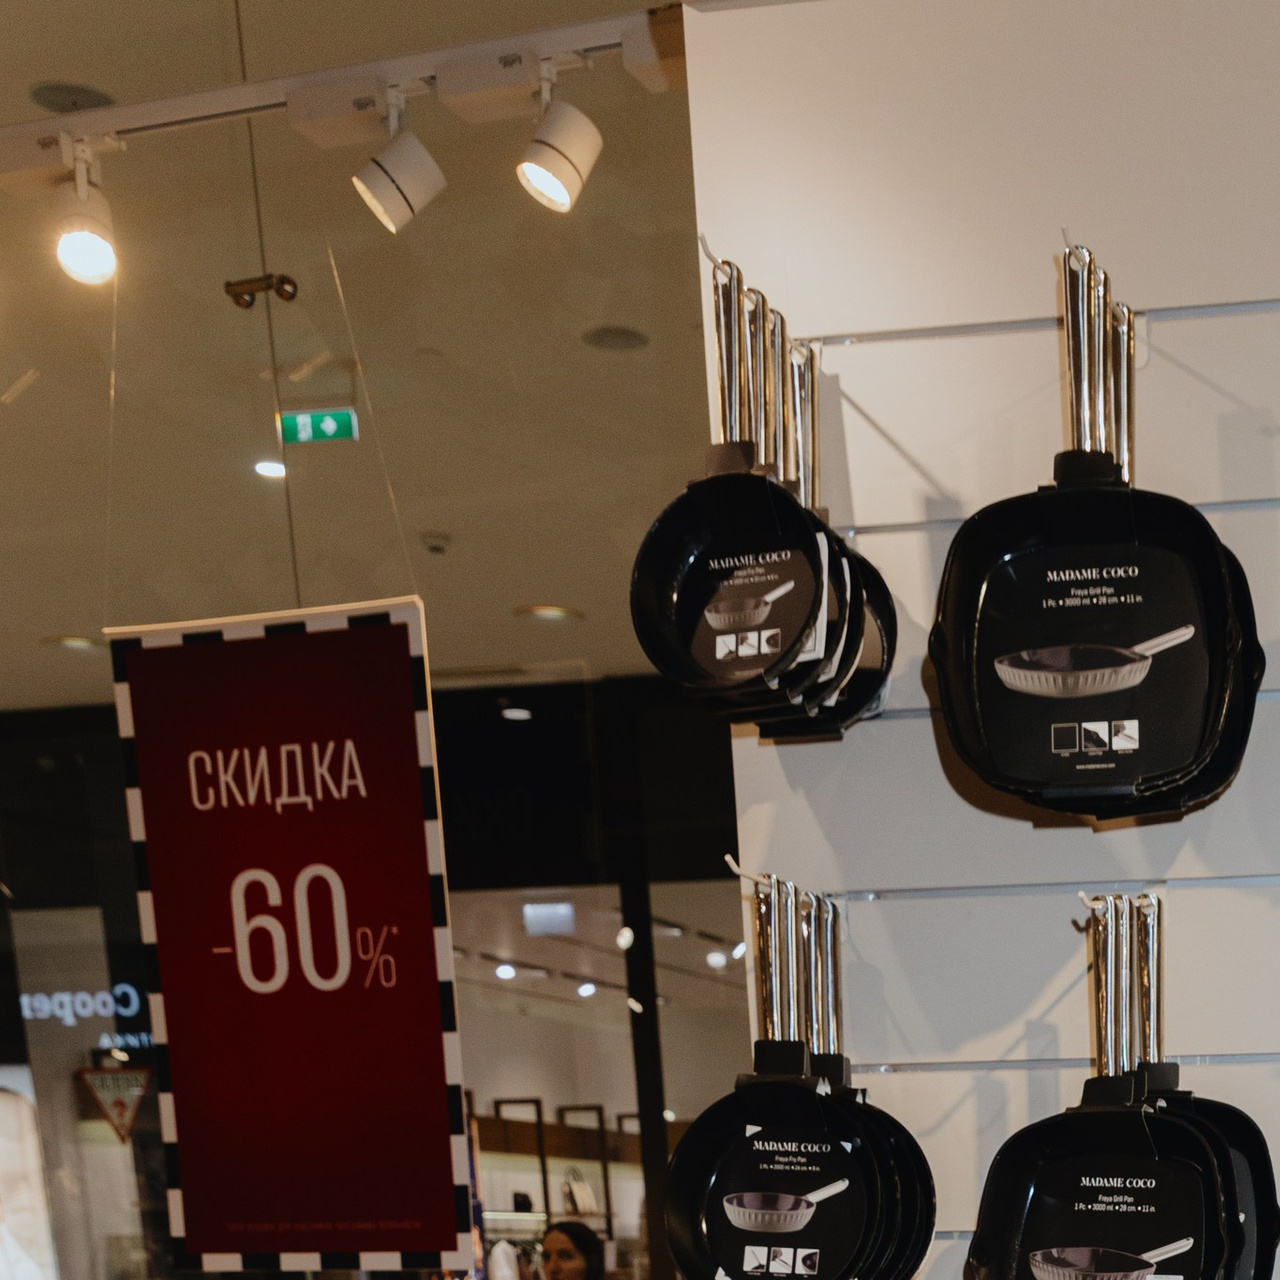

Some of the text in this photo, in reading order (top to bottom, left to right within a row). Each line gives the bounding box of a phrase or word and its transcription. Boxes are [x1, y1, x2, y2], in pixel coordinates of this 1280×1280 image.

[708, 550, 791, 570] MADAME COCO
[1047, 566, 1139, 582] MADAME COCO
[188, 739, 367, 814] СКИДКА
[753, 1140, 831, 1153] MADAME COCO
[1080, 1176, 1156, 1188] MADAME COCO
